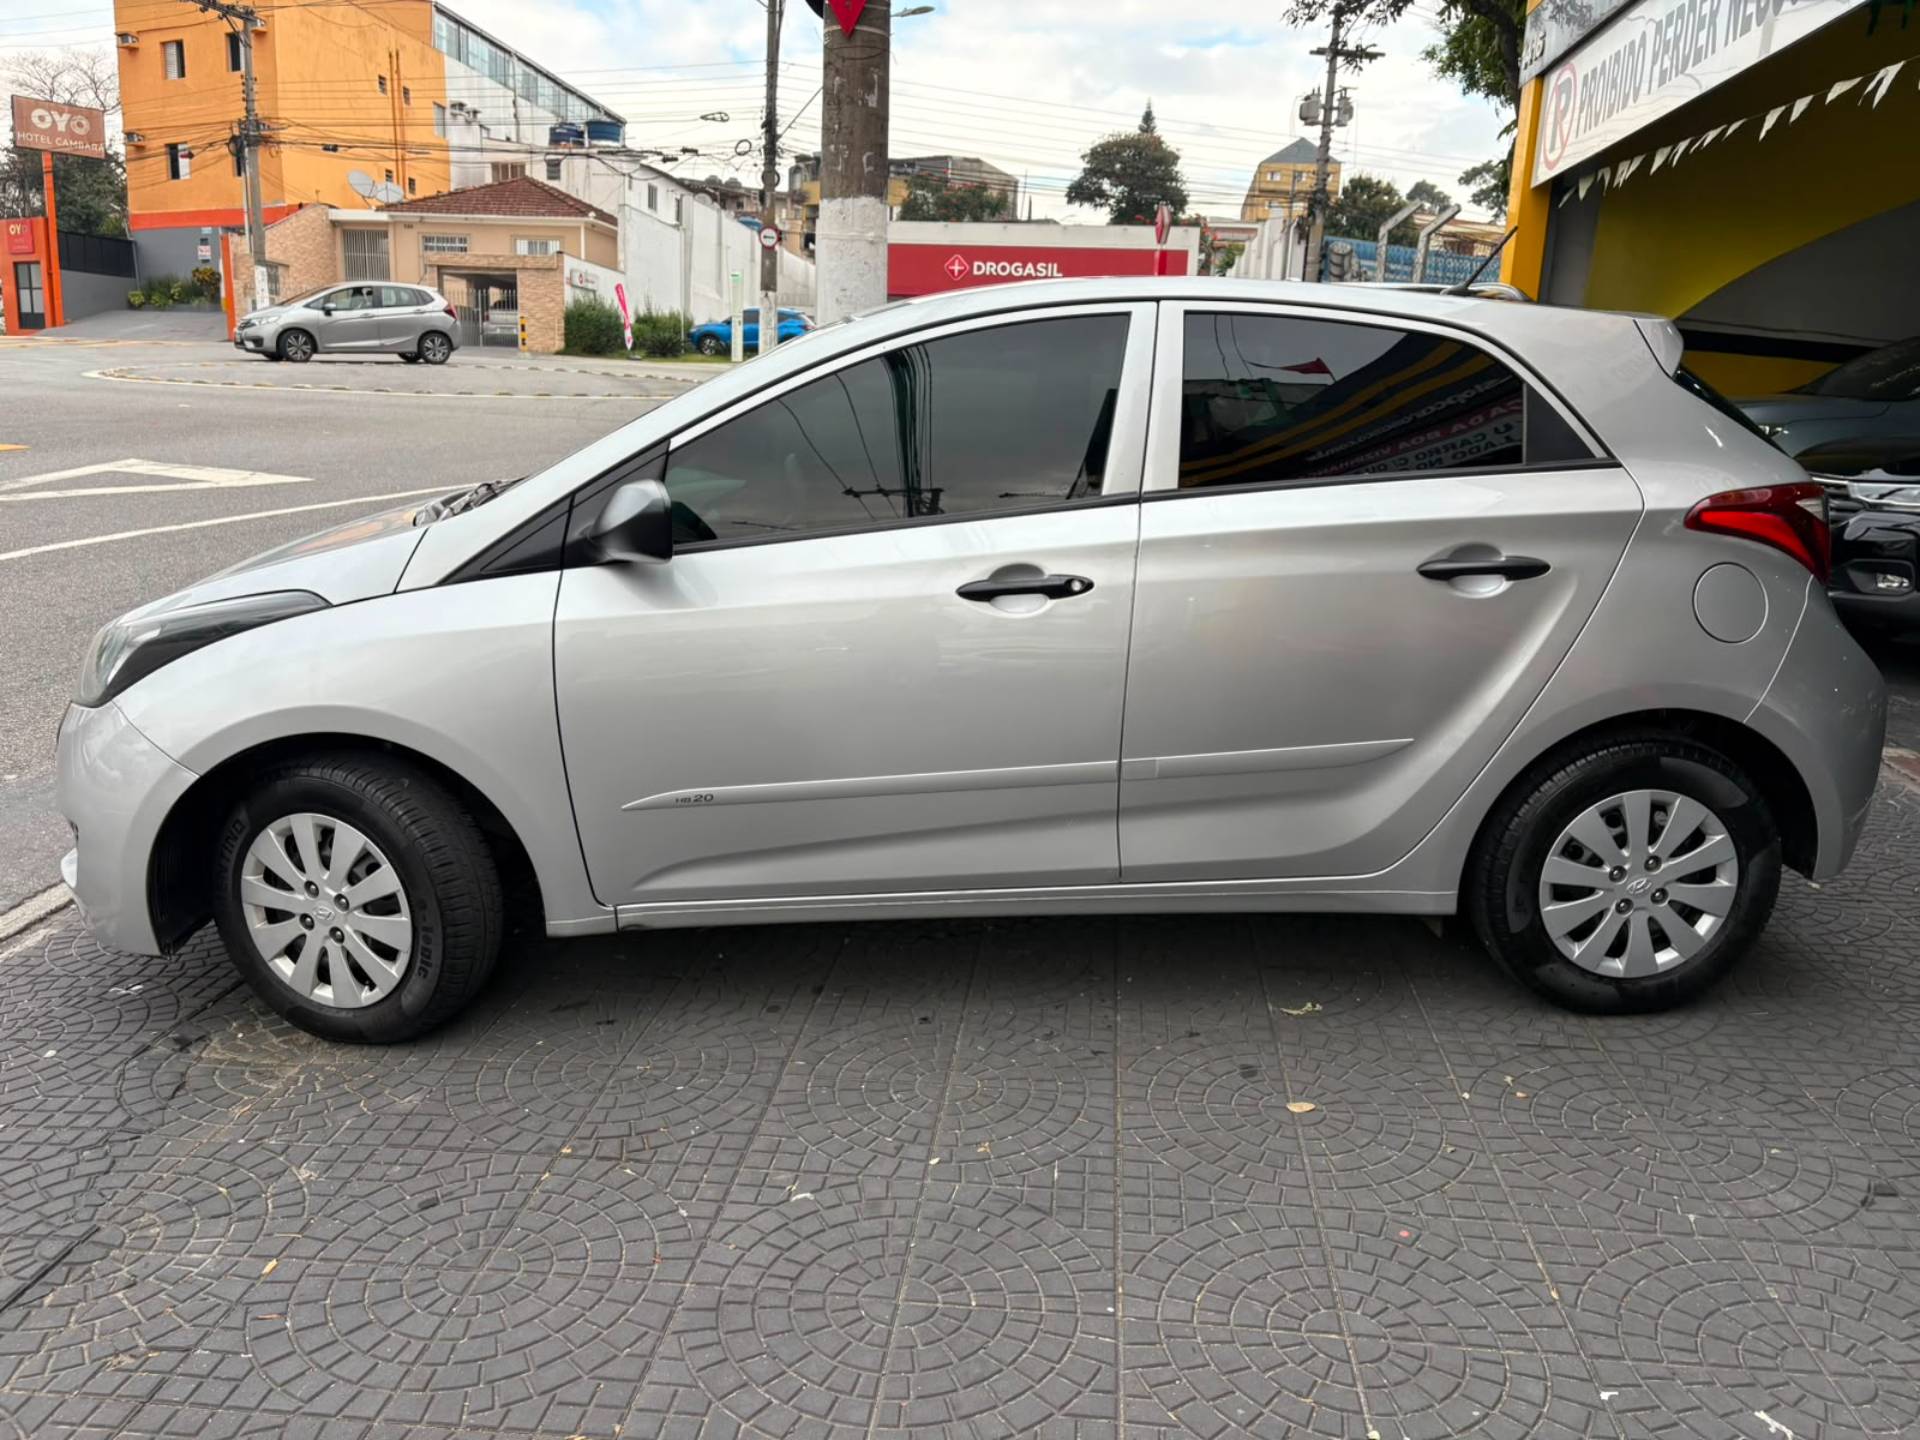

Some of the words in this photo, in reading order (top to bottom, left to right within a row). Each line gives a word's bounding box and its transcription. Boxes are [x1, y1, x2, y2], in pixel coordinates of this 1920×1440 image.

[1575, 30, 1648, 138] PROIBIDO
[1648, 0, 1721, 95] PERDER
[31, 108, 90, 135] OYO
[17, 131, 53, 145] HOTEL
[973, 261, 1063, 277] DROGASIL
